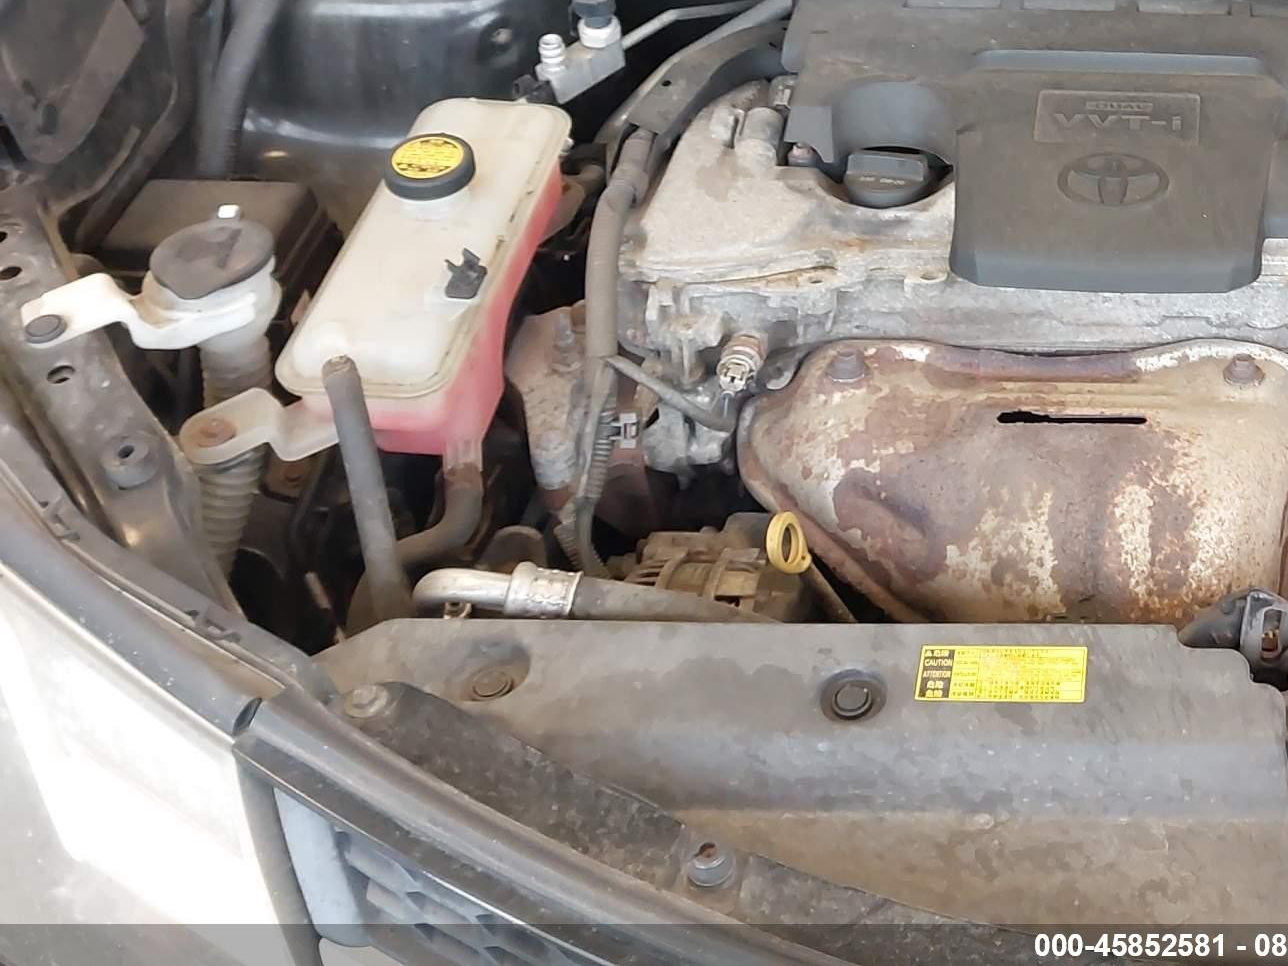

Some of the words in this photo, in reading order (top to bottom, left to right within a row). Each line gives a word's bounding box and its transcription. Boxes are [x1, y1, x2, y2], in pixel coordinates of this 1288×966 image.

[1053, 112, 1182, 132] VVT-i
[924, 658, 953, 668] CAUTION
[922, 670, 952, 679] ATTENTION
